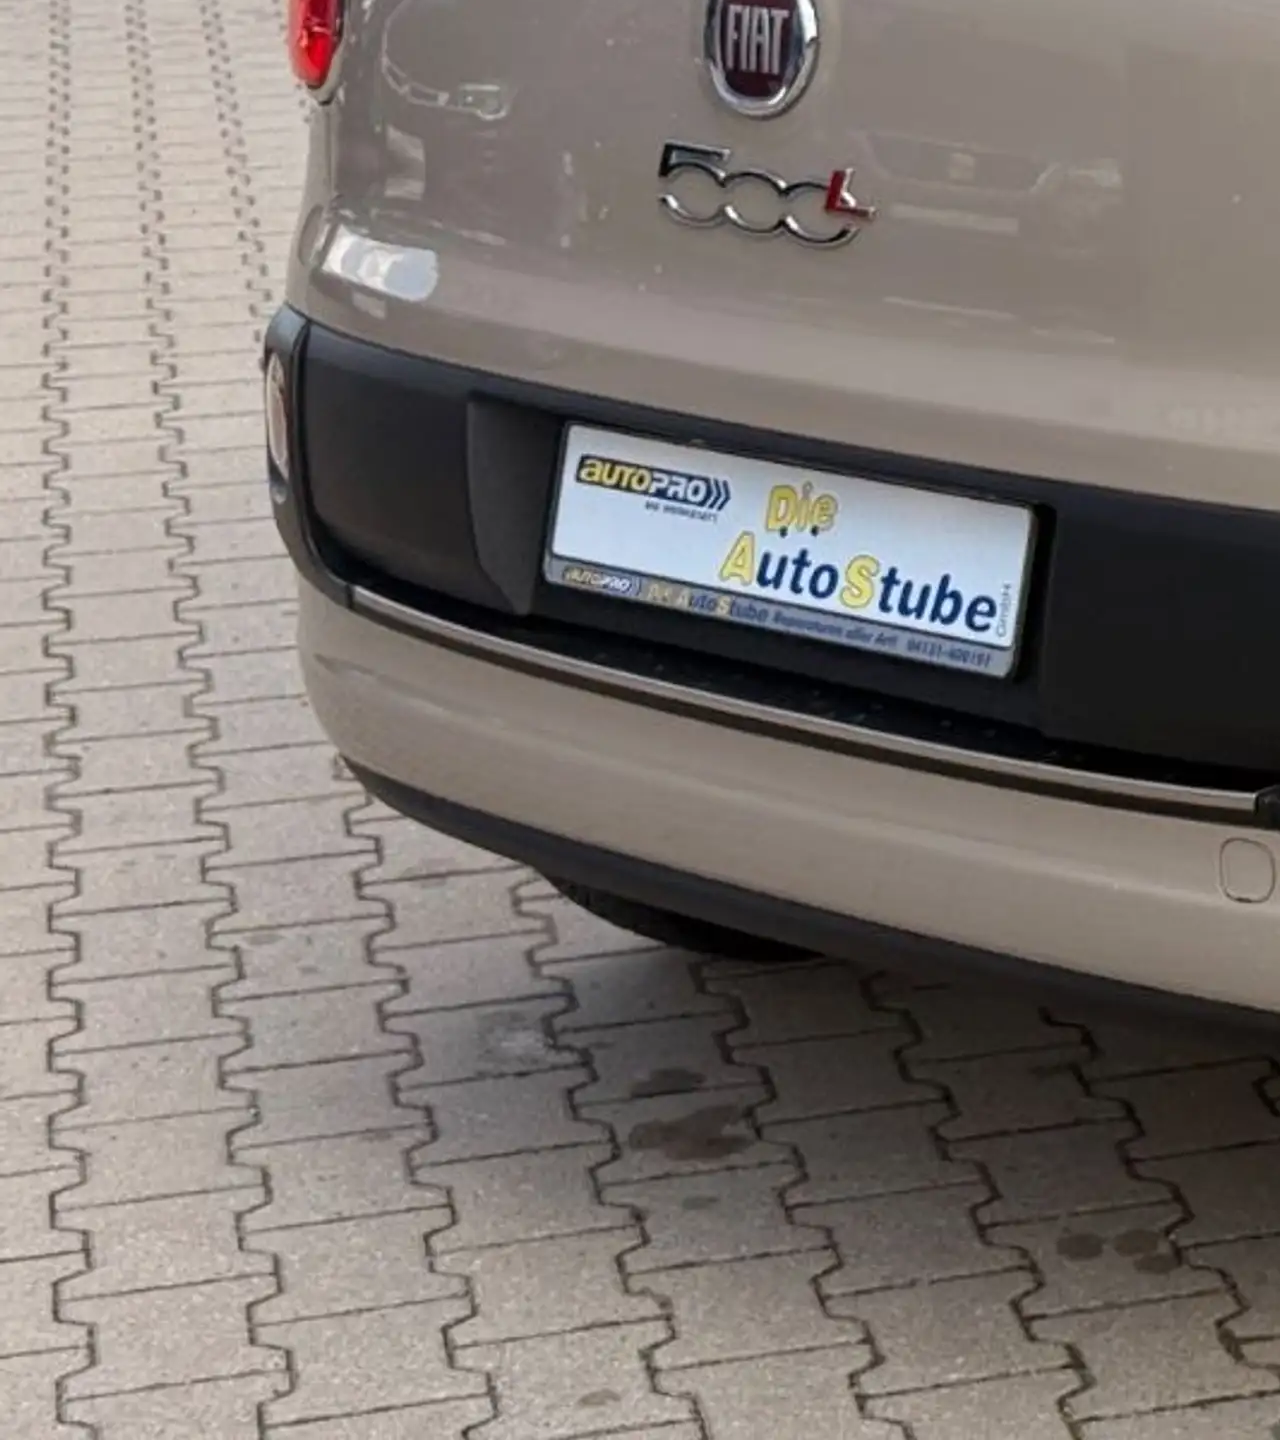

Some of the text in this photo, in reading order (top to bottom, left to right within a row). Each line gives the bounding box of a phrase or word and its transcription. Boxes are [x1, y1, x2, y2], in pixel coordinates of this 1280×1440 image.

[726, 4, 789, 75] FIAT
[659, 139, 877, 249] 500L
[766, 482, 840, 533] Die
[719, 531, 997, 634] AutoStube
